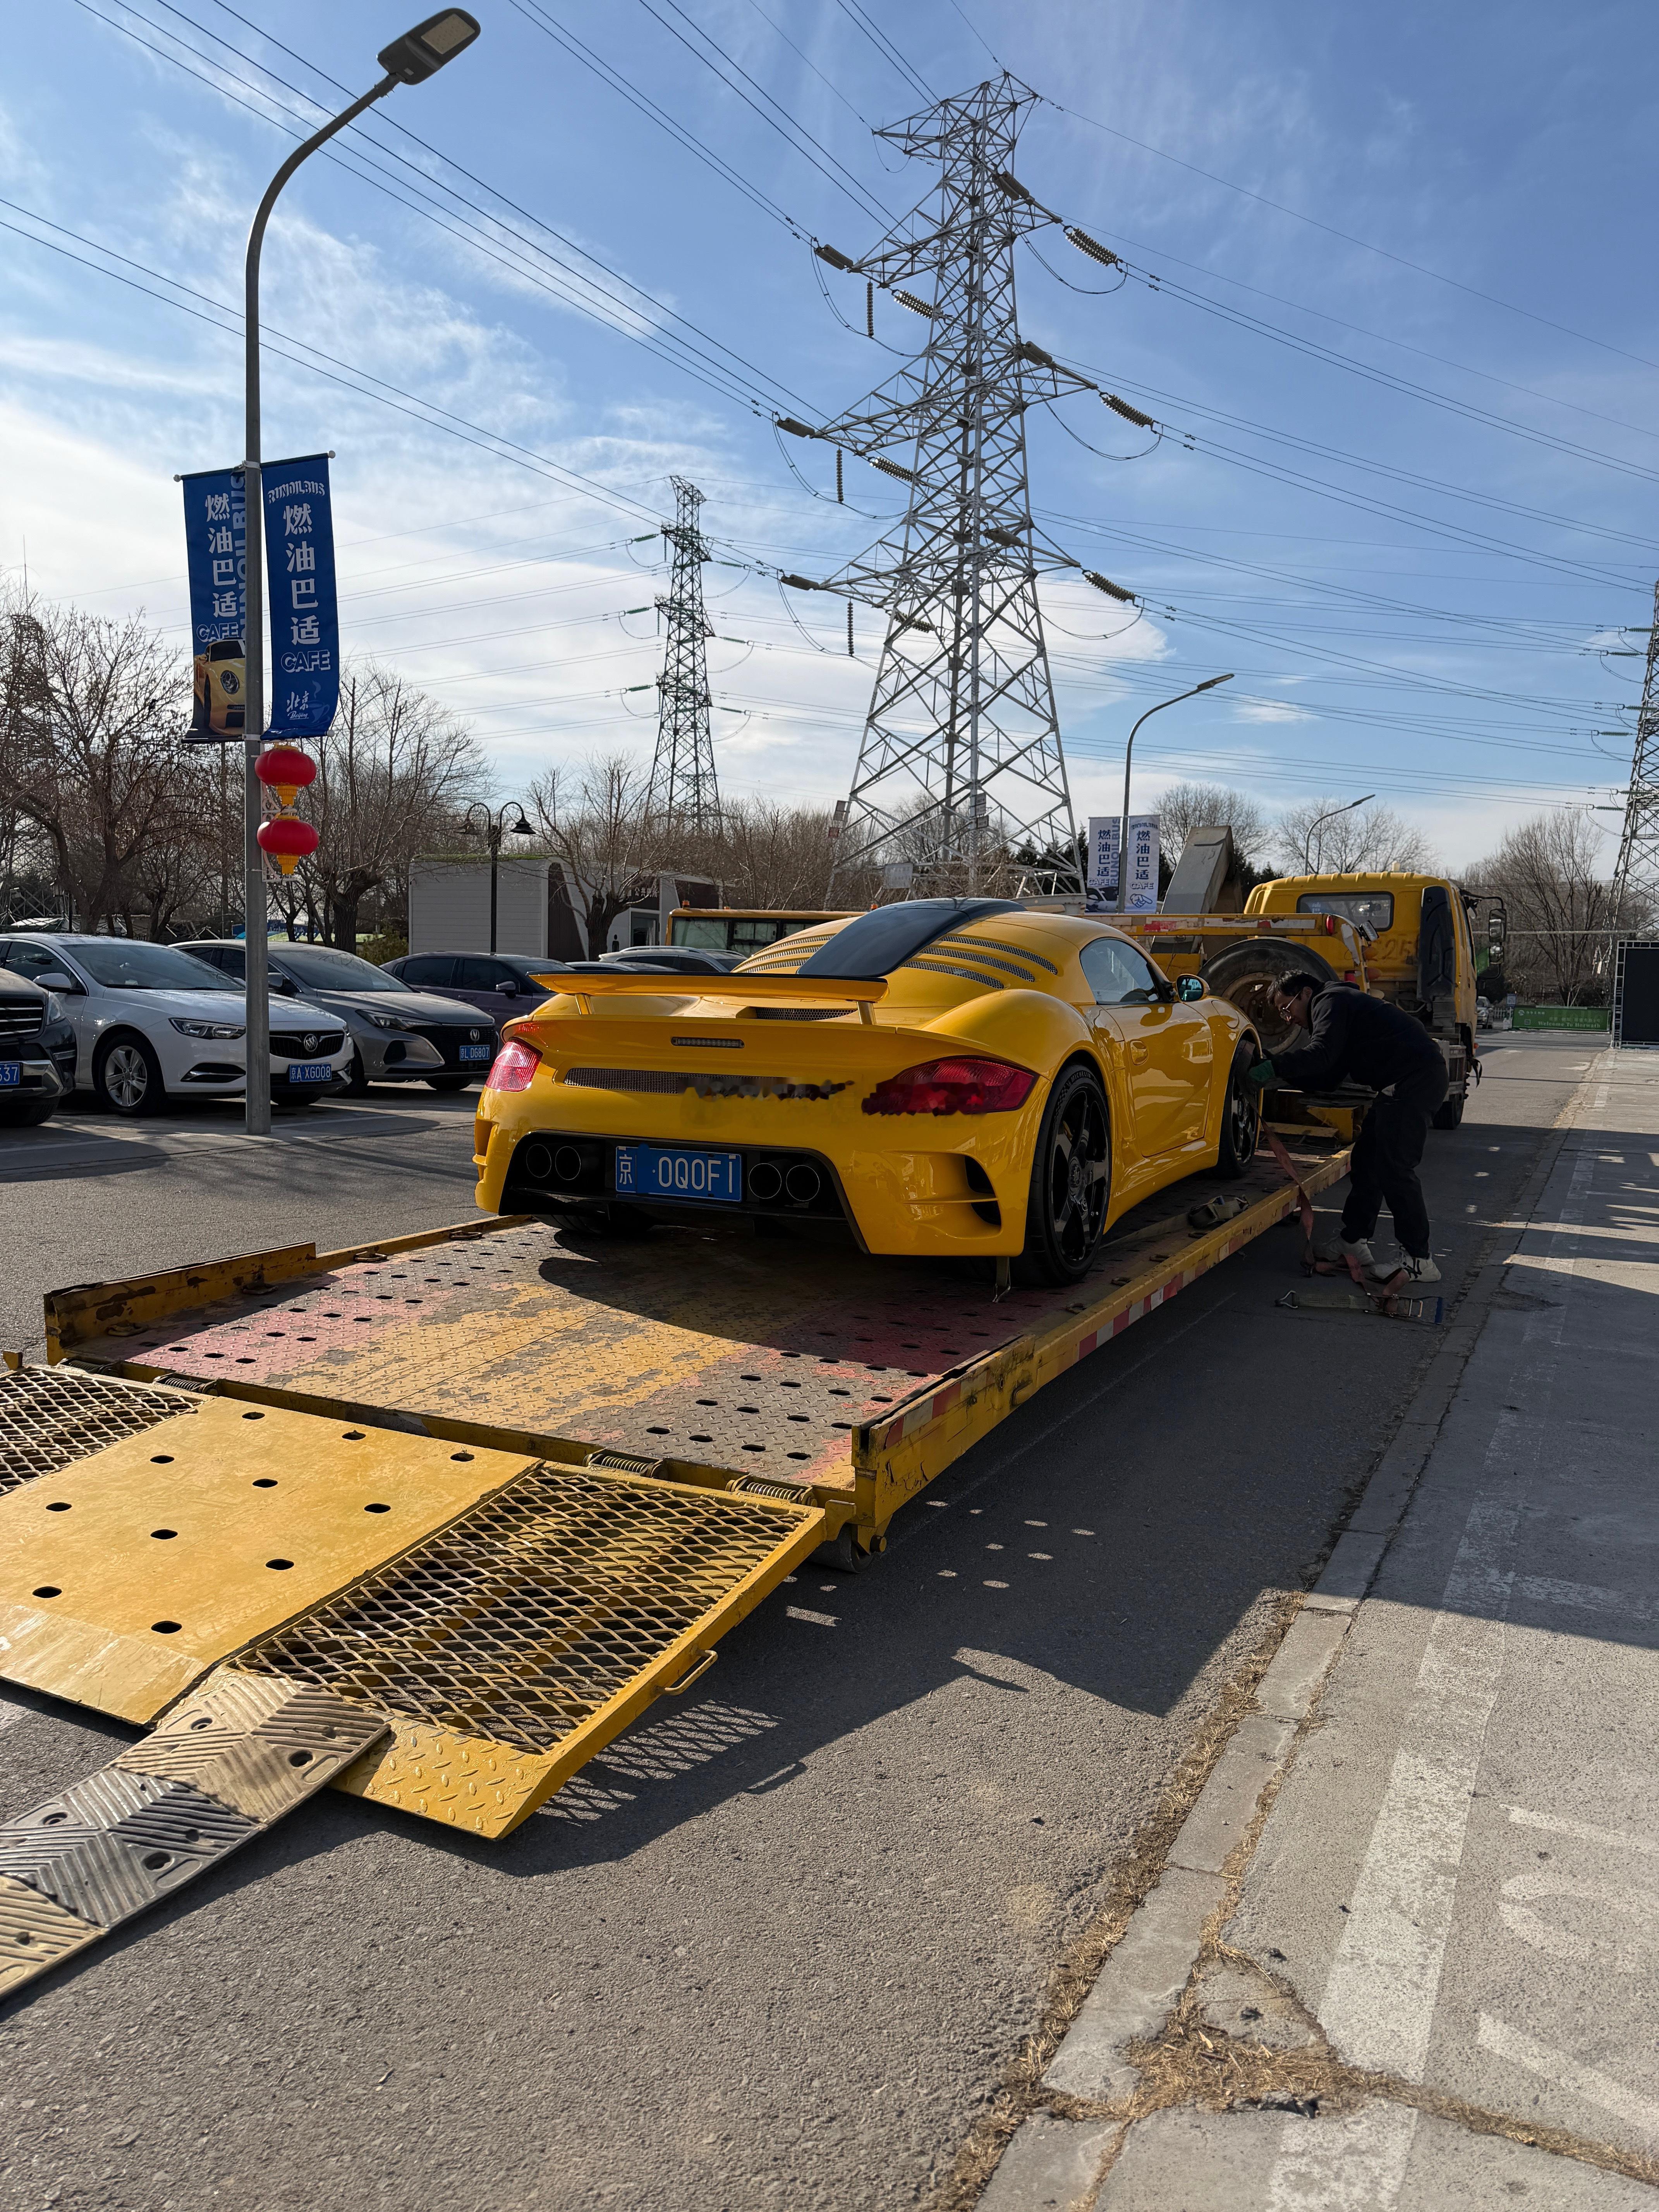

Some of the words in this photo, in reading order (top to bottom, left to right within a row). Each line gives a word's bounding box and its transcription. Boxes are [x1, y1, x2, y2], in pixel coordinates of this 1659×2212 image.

[205, 493, 237, 618] 燃油巴适
[283, 503, 320, 646] 燃油巴适
[196, 622, 239, 642] CAFE
[281, 649, 331, 673] CAFE
[287, 691, 309, 712] 北京
[287, 711, 308, 719] Beijing
[1097, 830, 1111, 876] 燃油巴适
[1110, 819, 1120, 885] RUNOILBUS
[1135, 830, 1150, 880] 燃油巴适
[0, 1066, 18, 1082] 37
